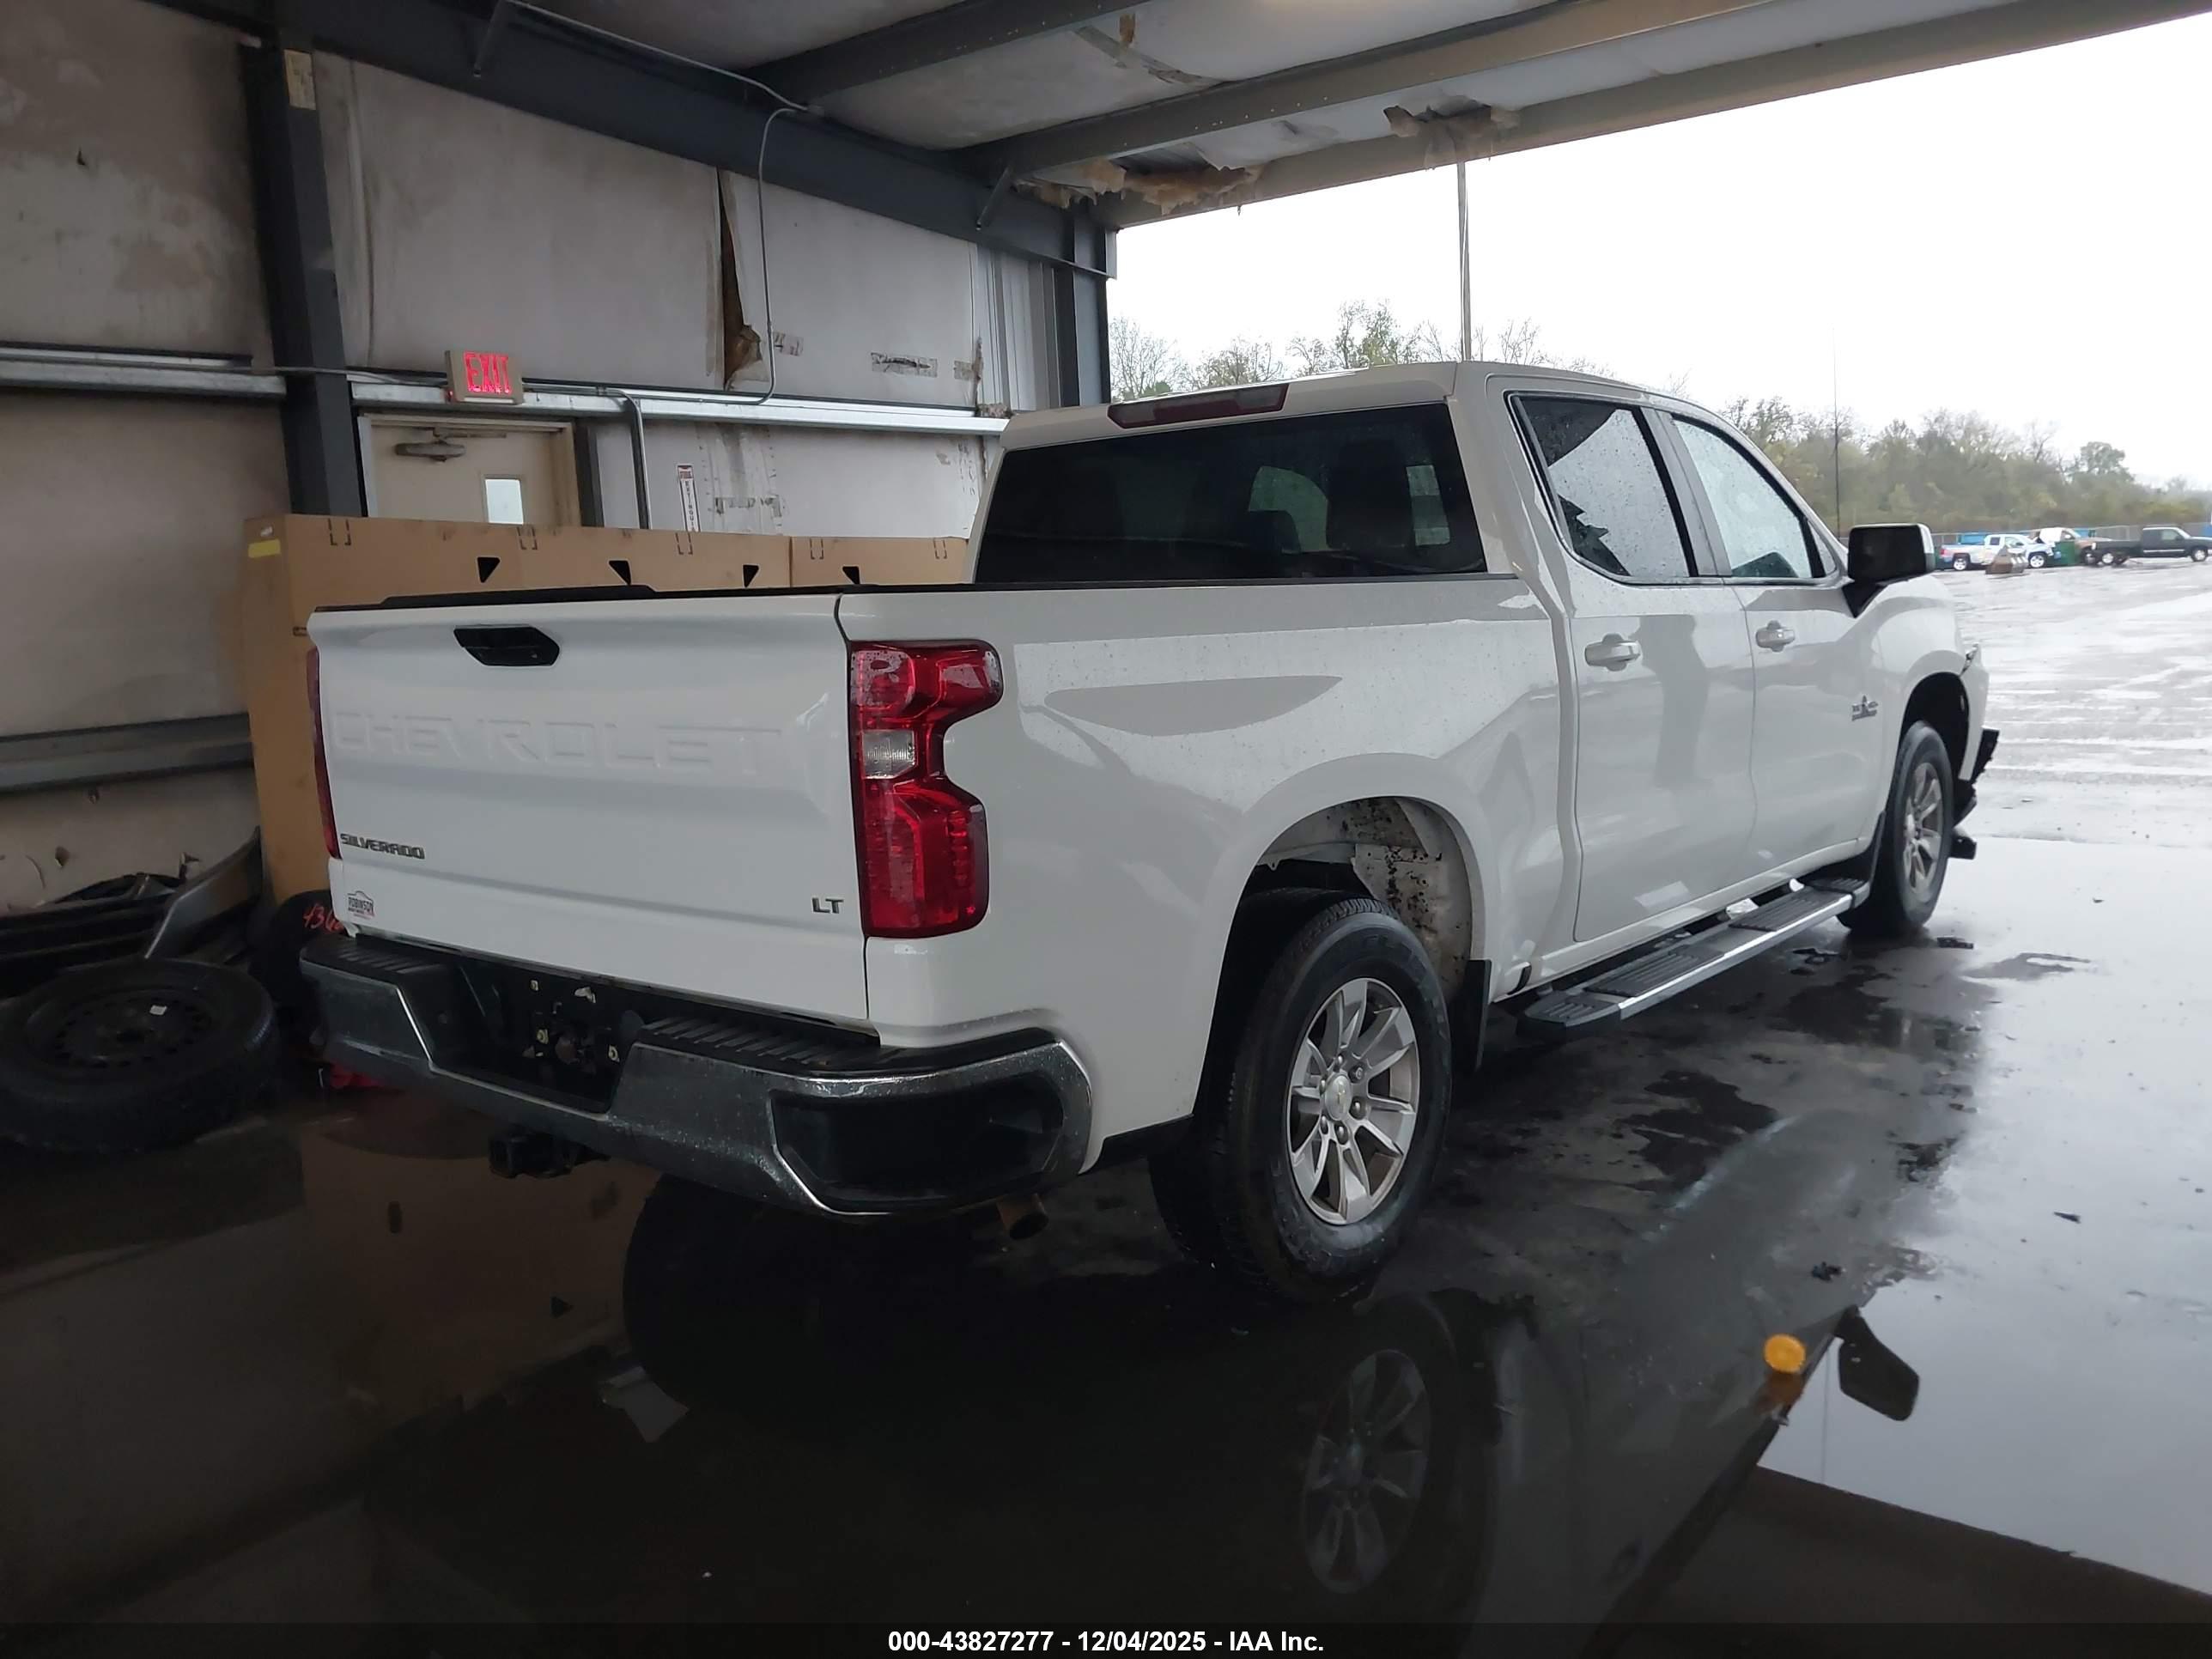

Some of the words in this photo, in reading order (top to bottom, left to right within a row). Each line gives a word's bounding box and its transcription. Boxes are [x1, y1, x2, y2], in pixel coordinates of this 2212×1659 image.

[465, 353, 510, 393] EXIT
[333, 712, 782, 775] CHEVROLET
[340, 833, 426, 860] SILVERADO
[812, 897, 844, 914] LT
